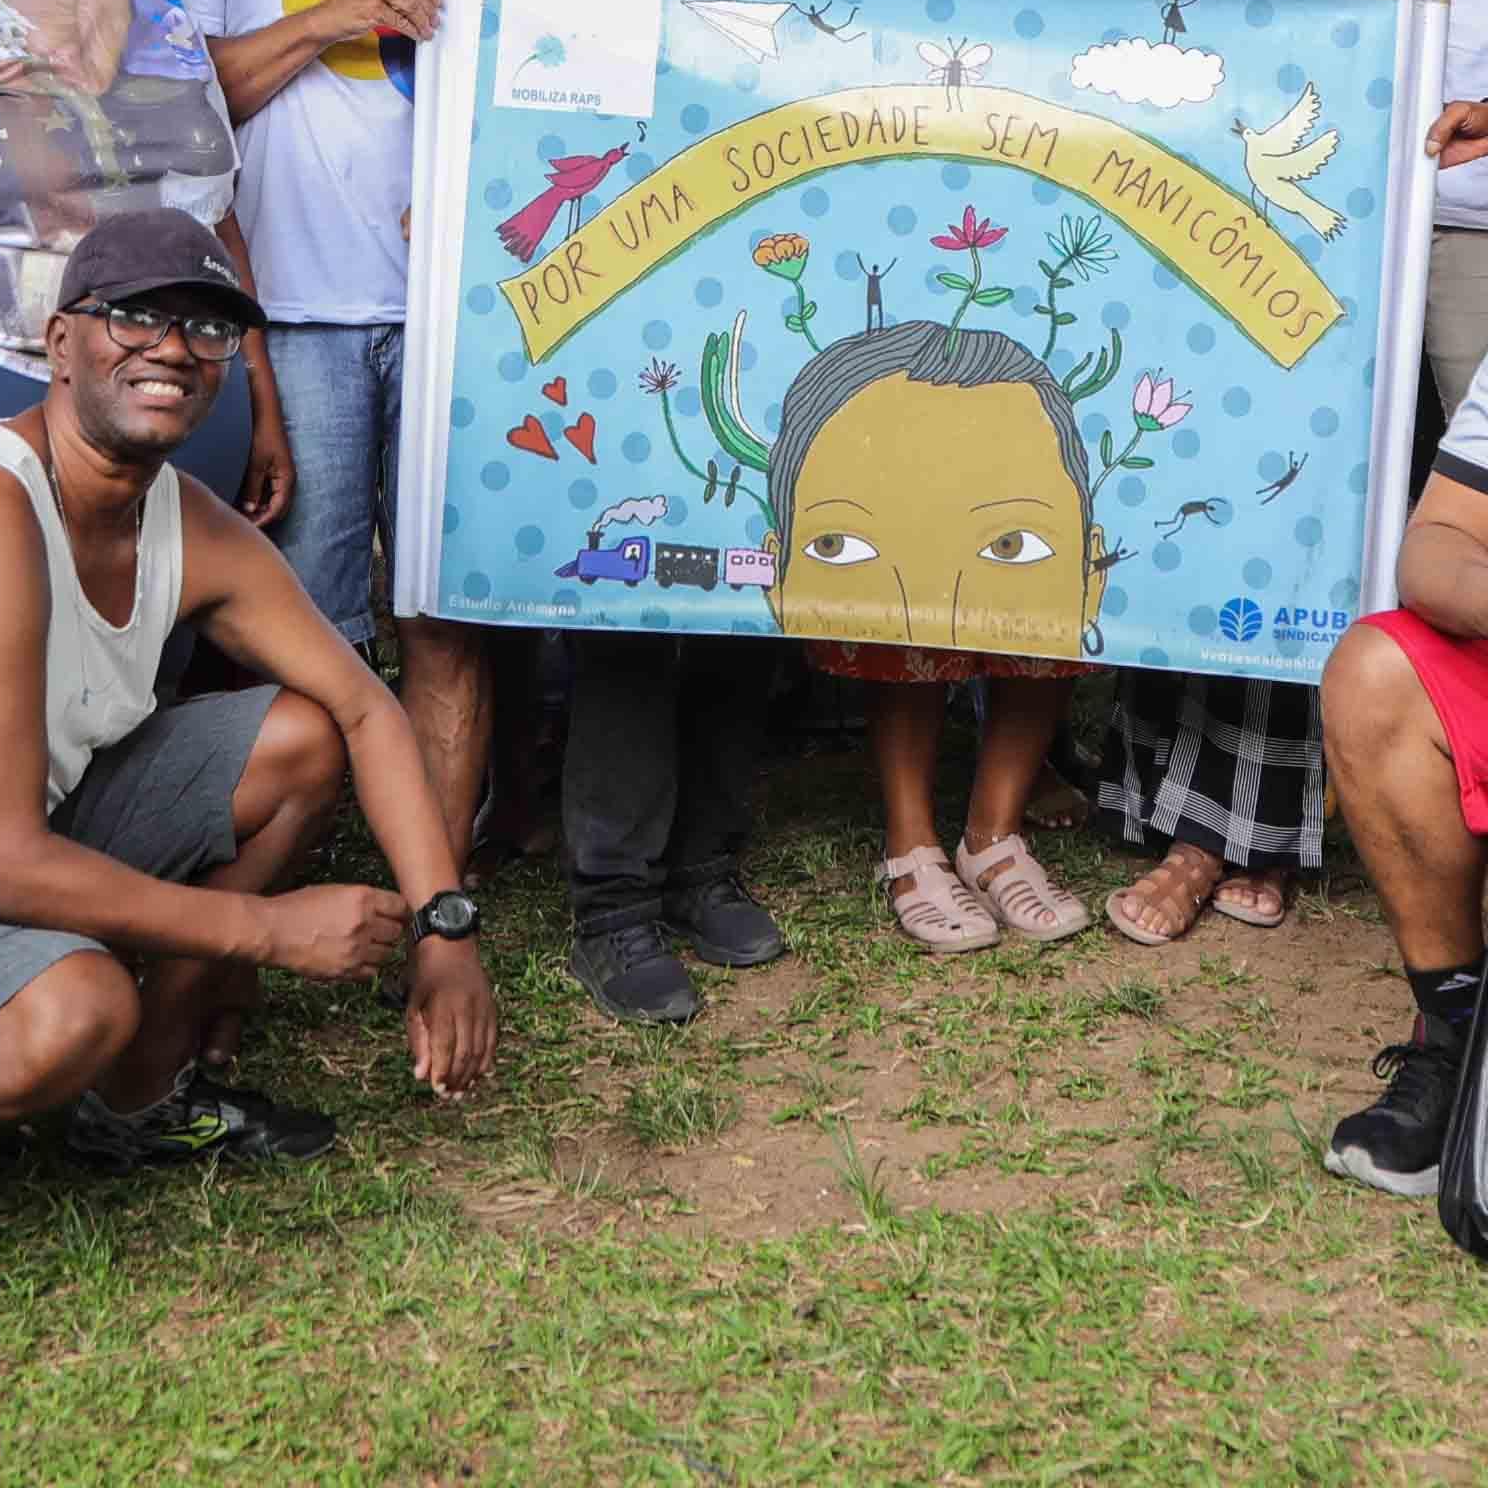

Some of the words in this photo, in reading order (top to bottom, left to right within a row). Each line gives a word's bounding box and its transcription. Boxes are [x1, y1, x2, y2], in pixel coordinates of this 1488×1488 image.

[512, 87, 567, 104] MOBILIZA
[569, 92, 601, 106] RAPS
[521, 240, 601, 325] POR
[609, 183, 697, 252] UMA
[725, 105, 930, 193] SOCIEDADE
[981, 112, 1060, 168] SEM
[1091, 149, 1325, 339] MANICÔMIOS
[1273, 607, 1348, 630] APUB
[1272, 629, 1341, 644] SINDICAT
